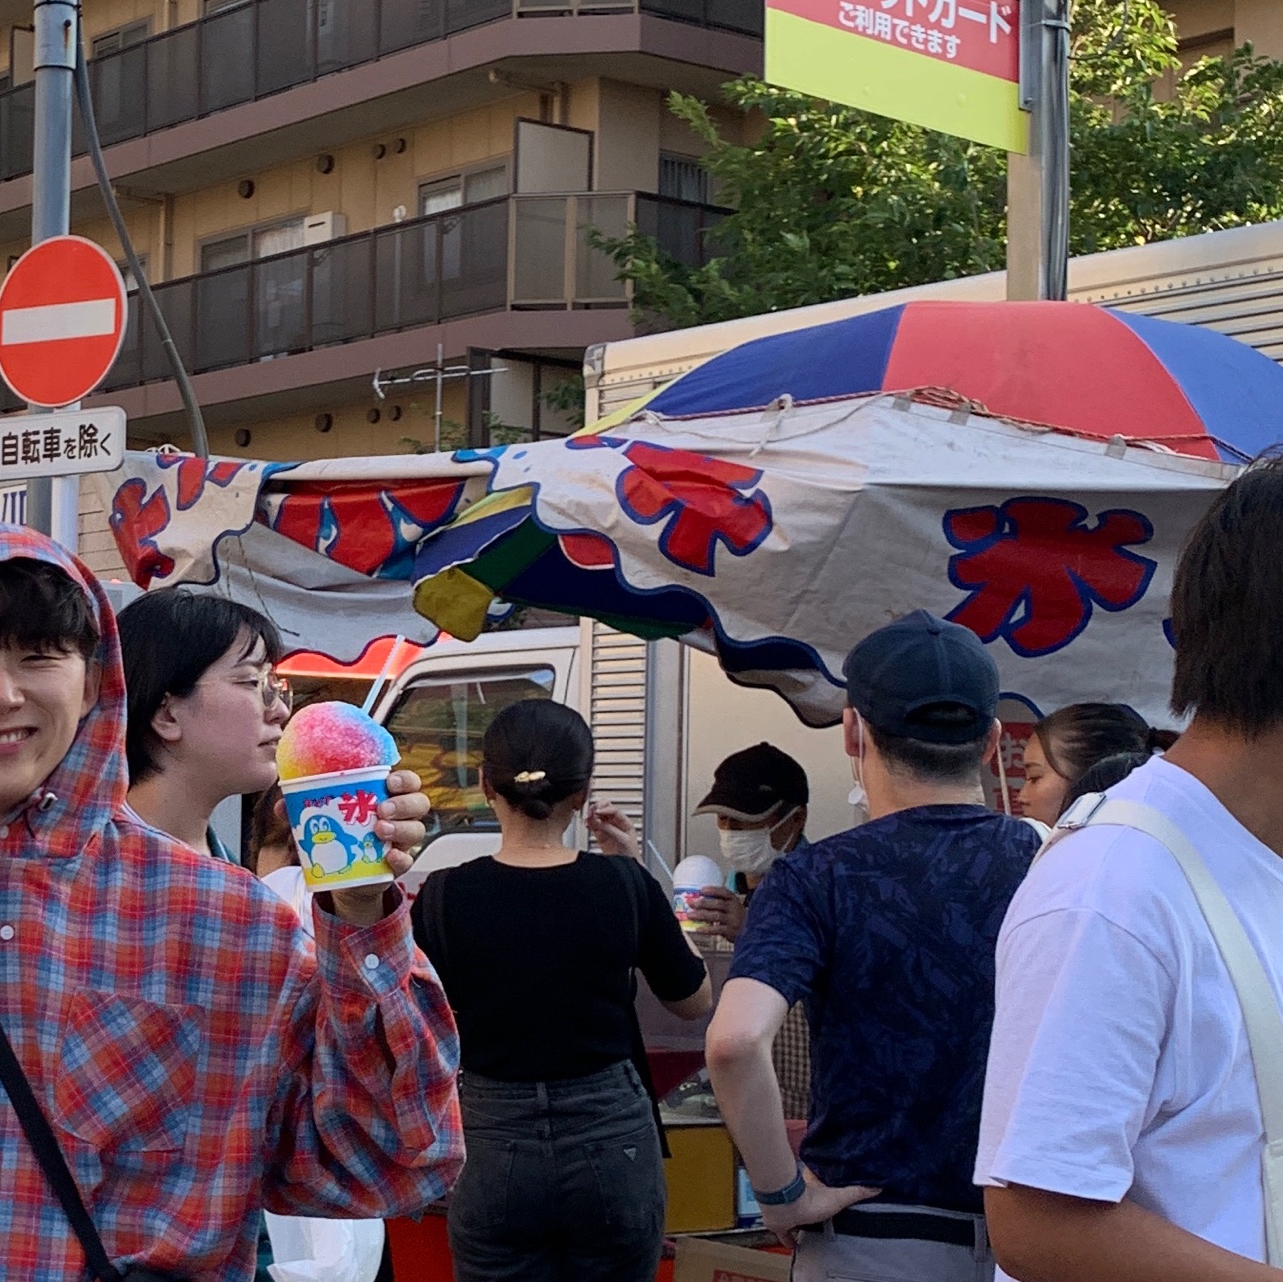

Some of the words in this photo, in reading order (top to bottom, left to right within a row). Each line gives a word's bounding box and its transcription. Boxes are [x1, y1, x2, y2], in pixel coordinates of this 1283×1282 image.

[839, 1, 960, 58] ご利用できます
[2, 423, 111, 465] 自転車を除く
[942, 496, 1158, 658] 氷
[338, 789, 379, 826] 氷
